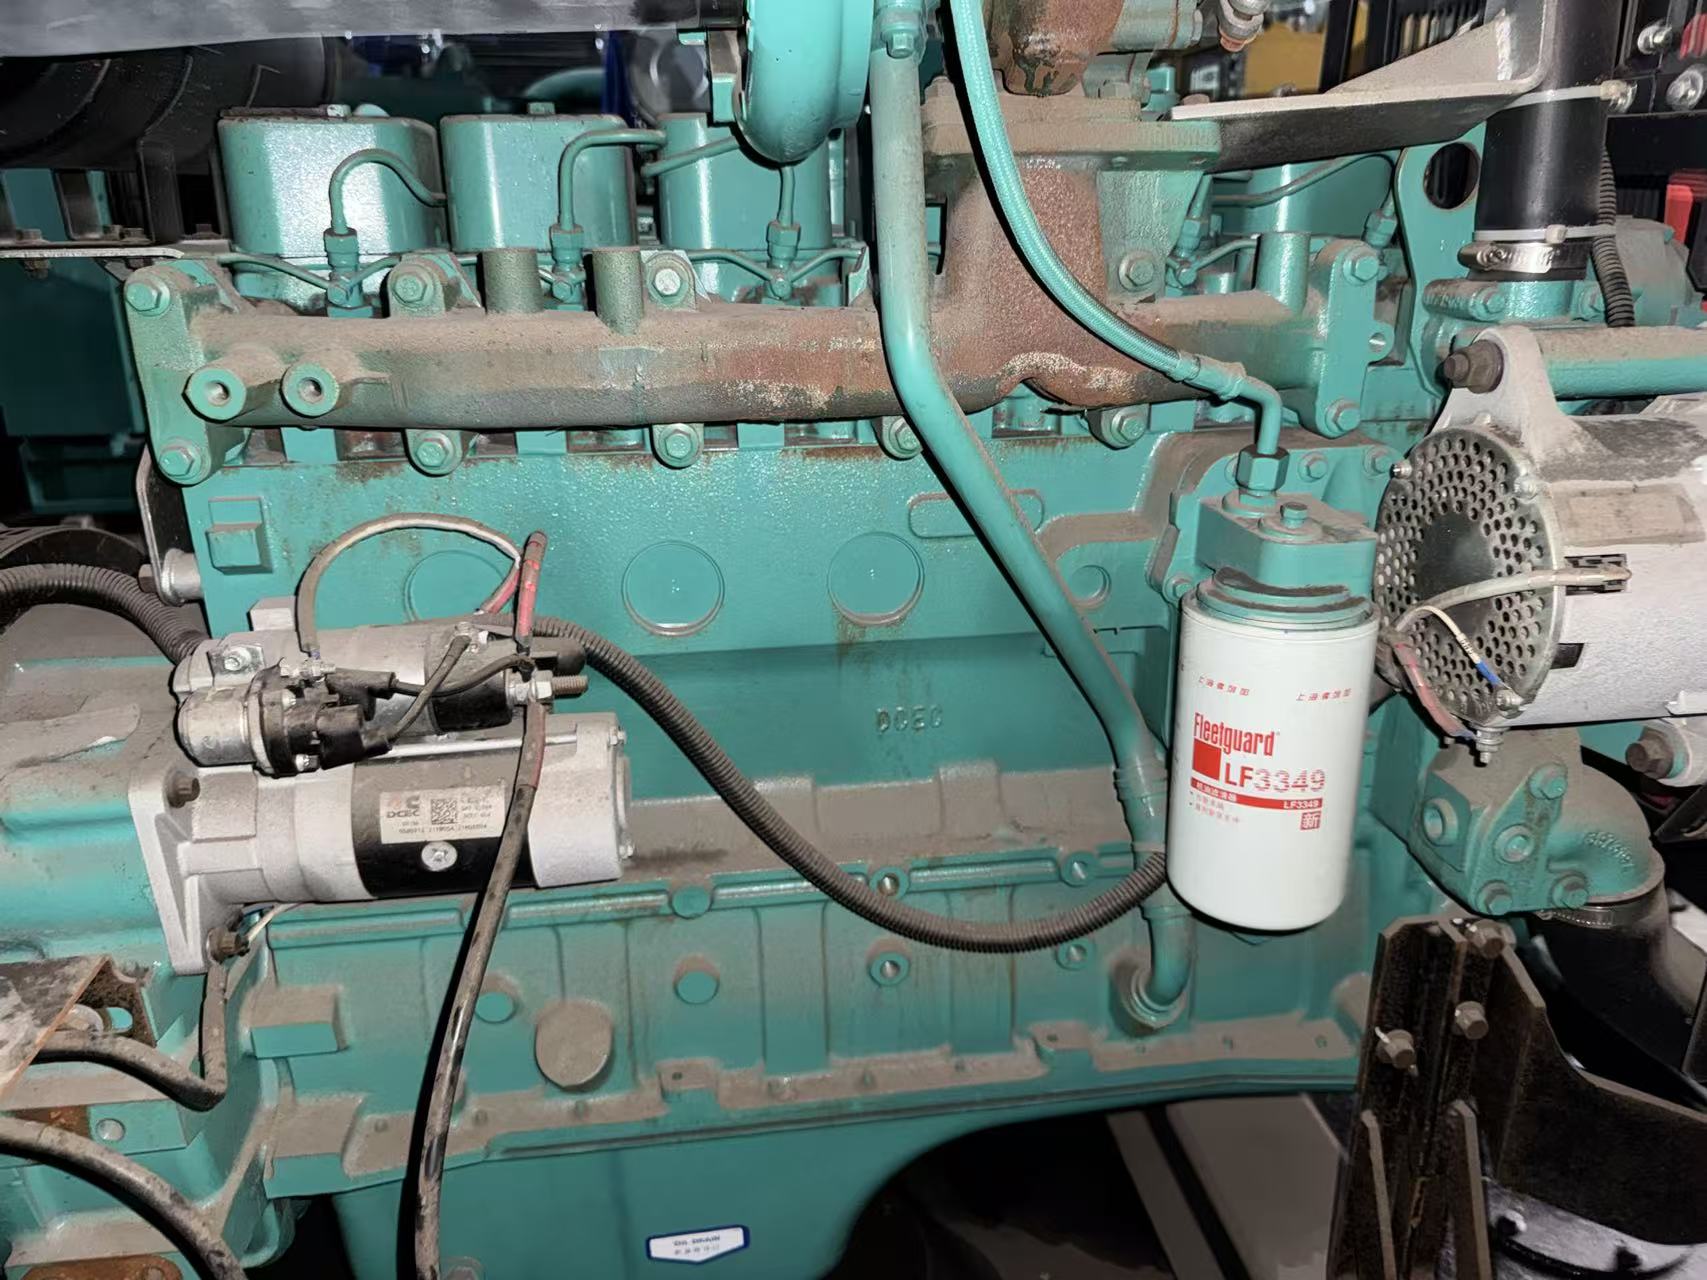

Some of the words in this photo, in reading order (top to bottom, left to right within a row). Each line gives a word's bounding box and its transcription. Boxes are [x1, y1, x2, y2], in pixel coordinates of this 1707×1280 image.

[1194, 712, 1275, 756] Fleetguard
[1225, 763, 1326, 792] LF3349
[1283, 799, 1320, 809] LF3349
